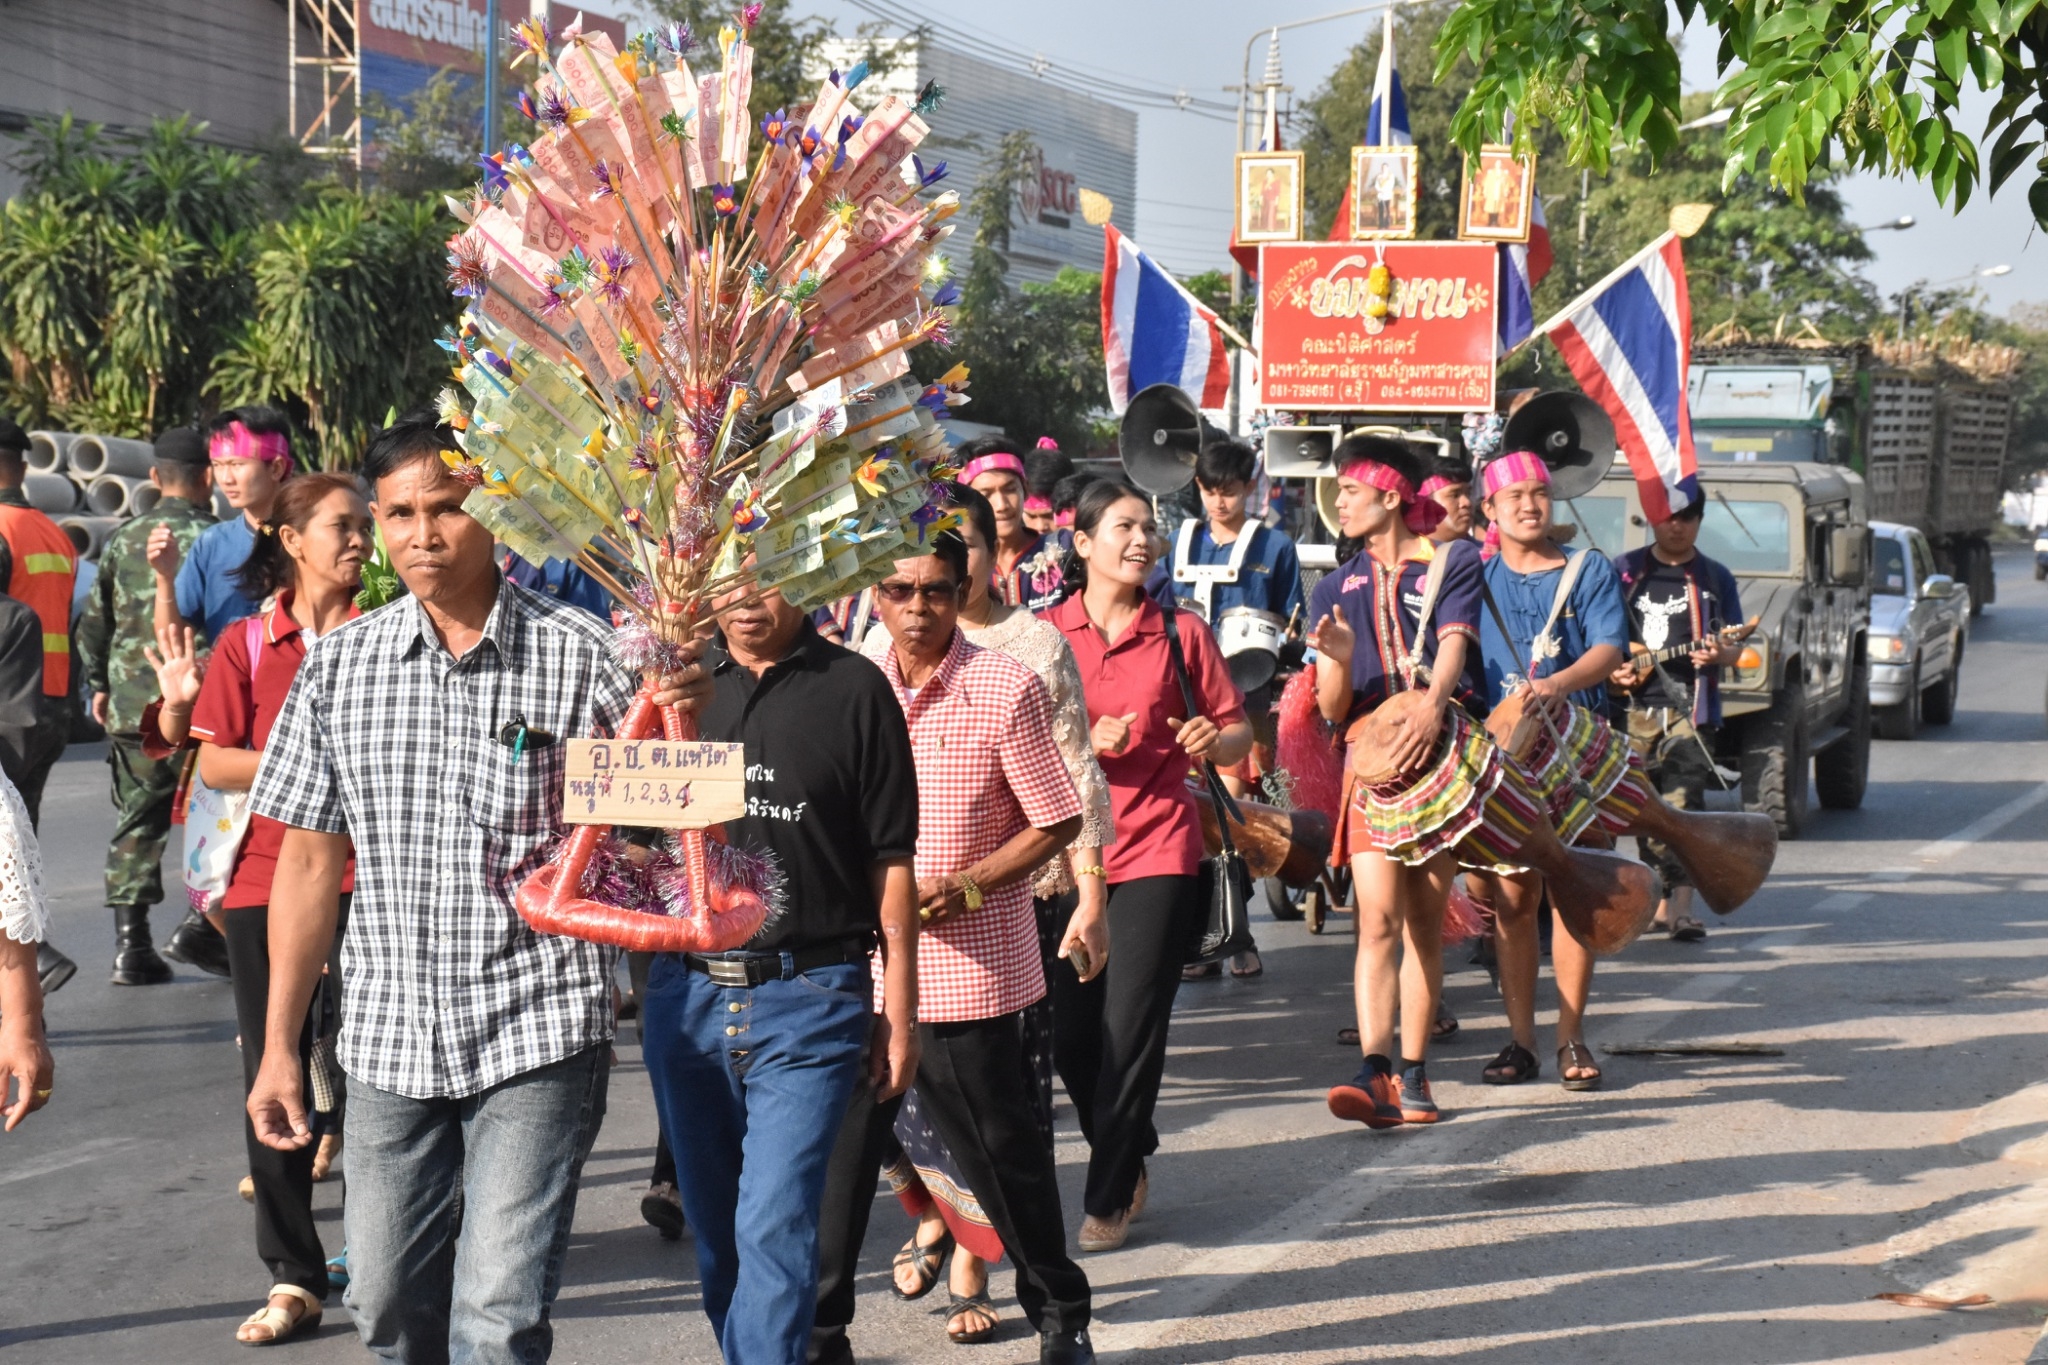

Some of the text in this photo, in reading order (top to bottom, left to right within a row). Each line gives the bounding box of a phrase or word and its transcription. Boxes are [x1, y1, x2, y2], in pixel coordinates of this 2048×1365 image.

[1041, 166, 1076, 215] SCG
[1302, 331, 1419, 354] คณะนิติศาสตร์
[1269, 358, 1488, 383] มหาวิทยาลัยราชภัฏมหาสารคาม
[744, 763, 774, 782] ตใน
[745, 796, 807, 822] นิรันดร์
